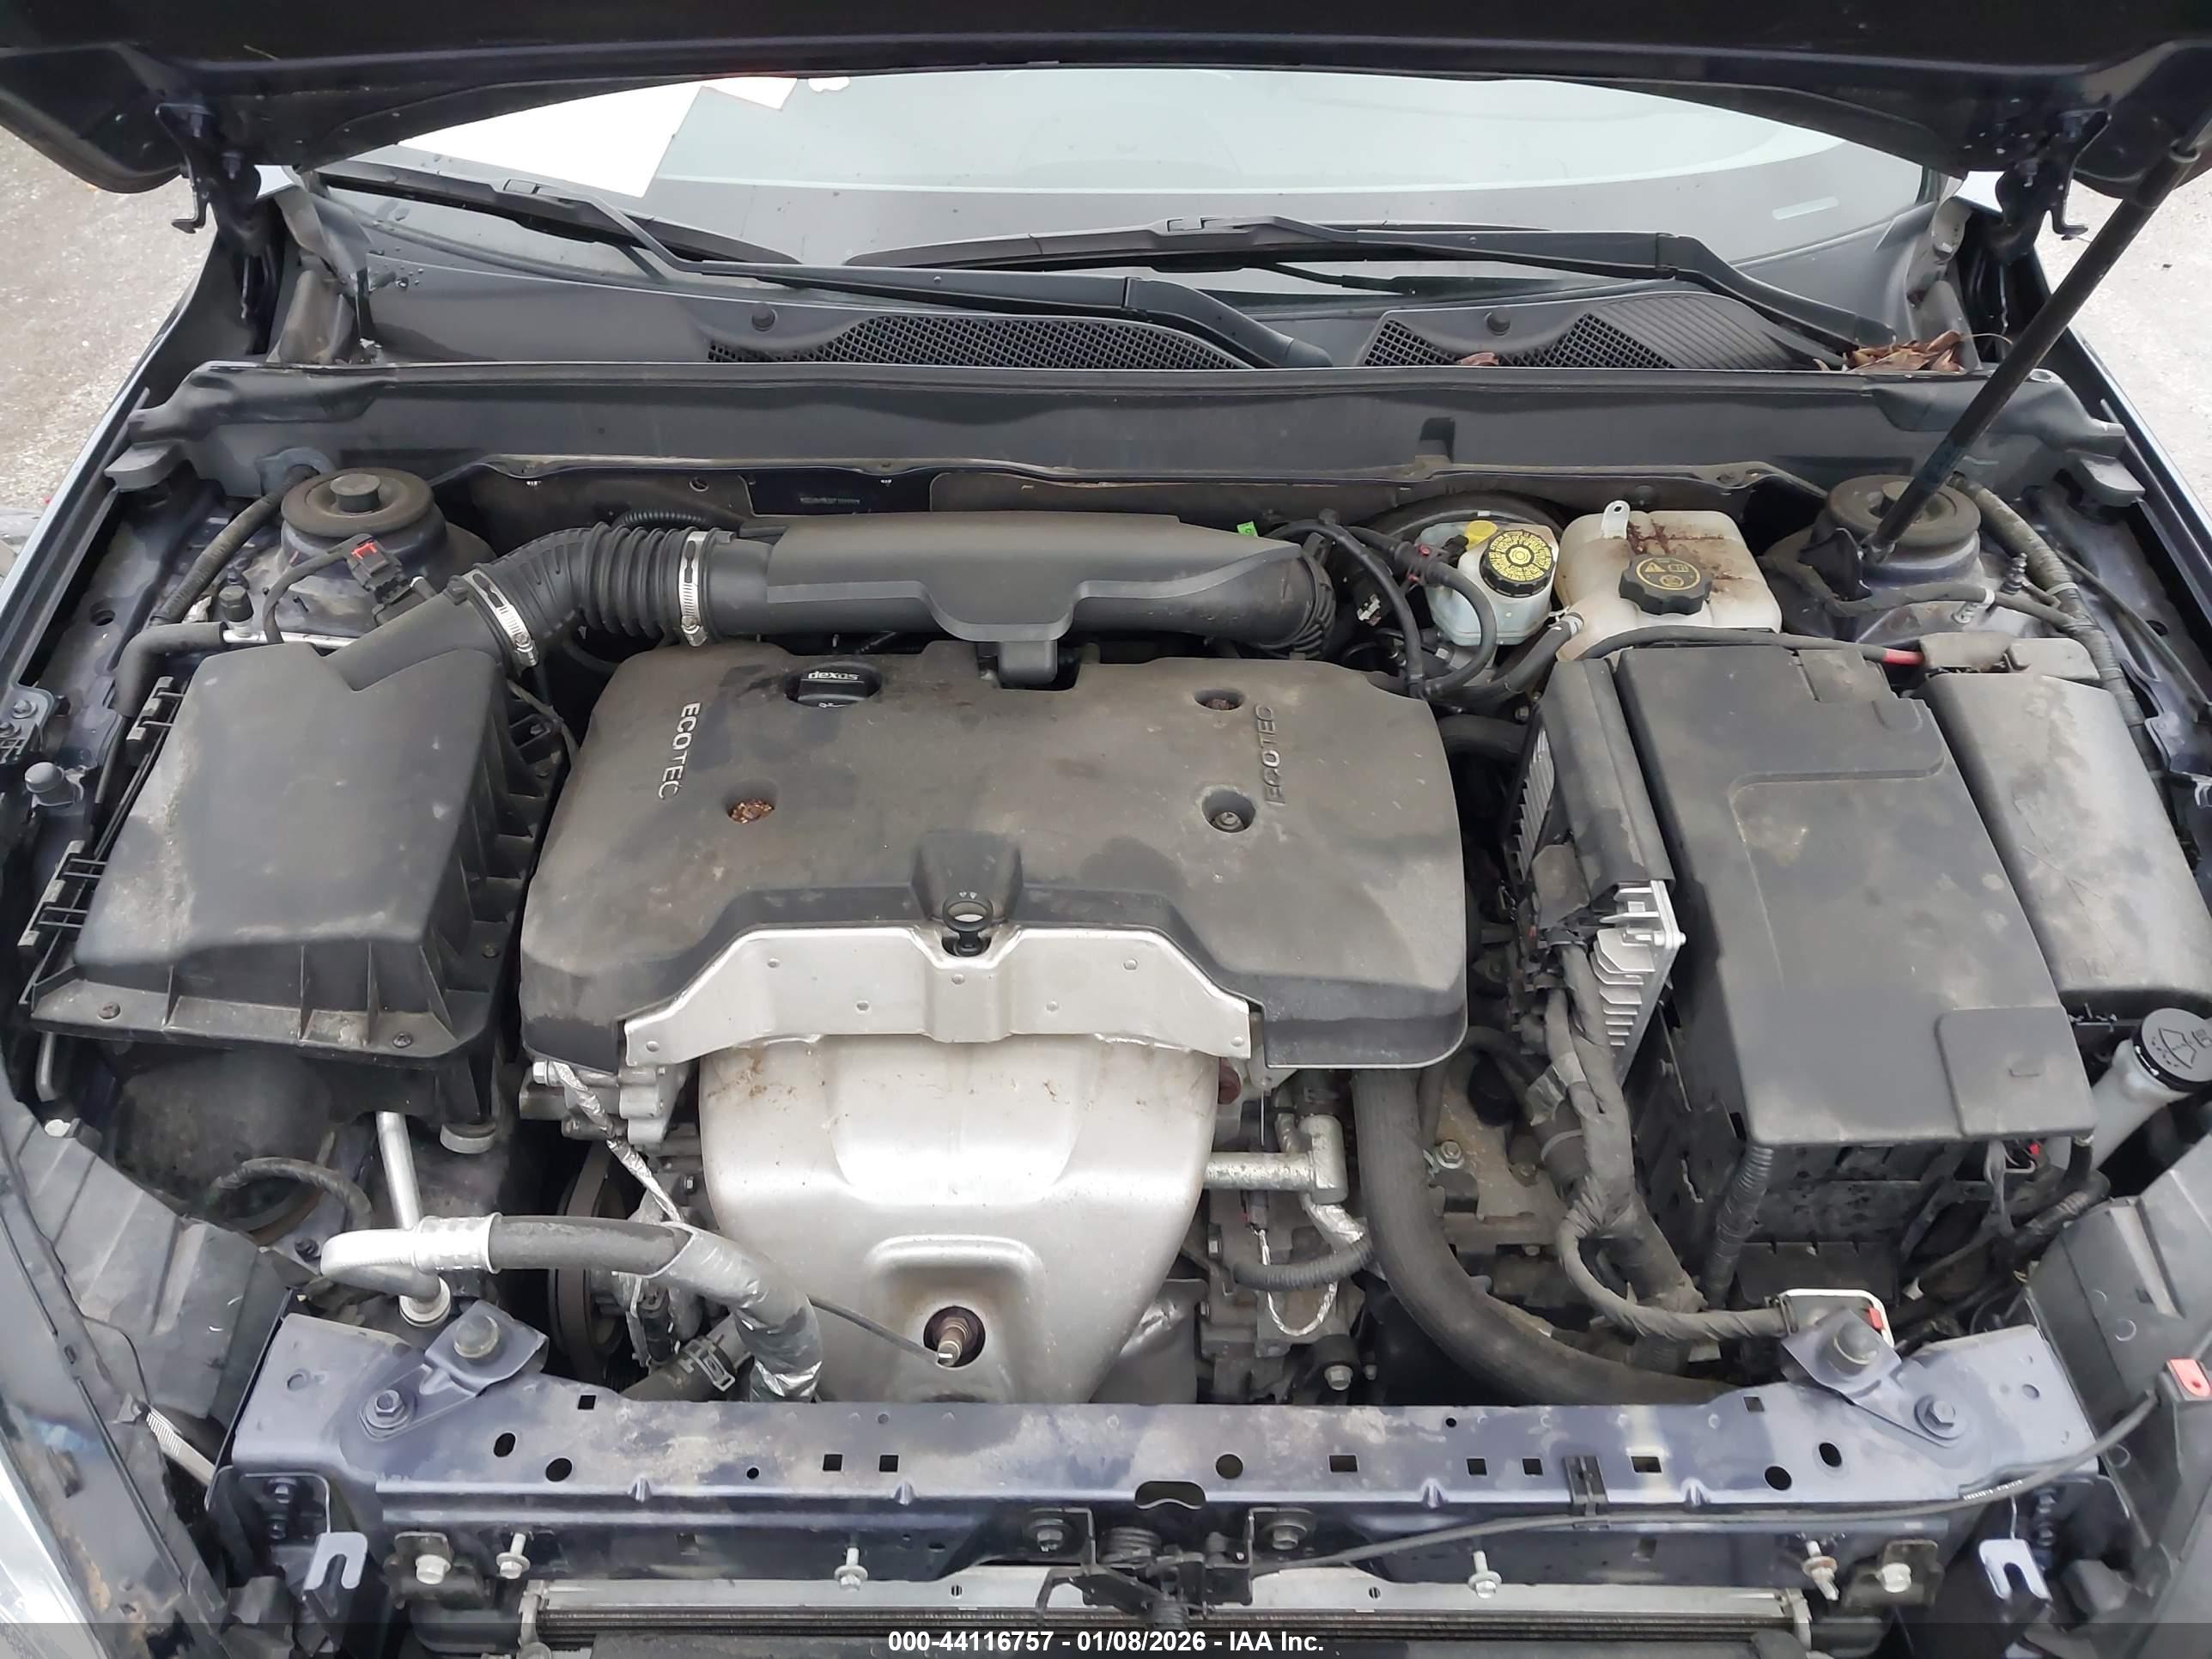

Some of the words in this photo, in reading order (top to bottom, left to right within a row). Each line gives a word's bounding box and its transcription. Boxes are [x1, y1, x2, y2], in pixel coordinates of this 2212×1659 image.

[807, 671, 860, 681] dexos
[658, 702, 702, 800] ECOTEC
[1255, 705, 1285, 805] ECOTEC
